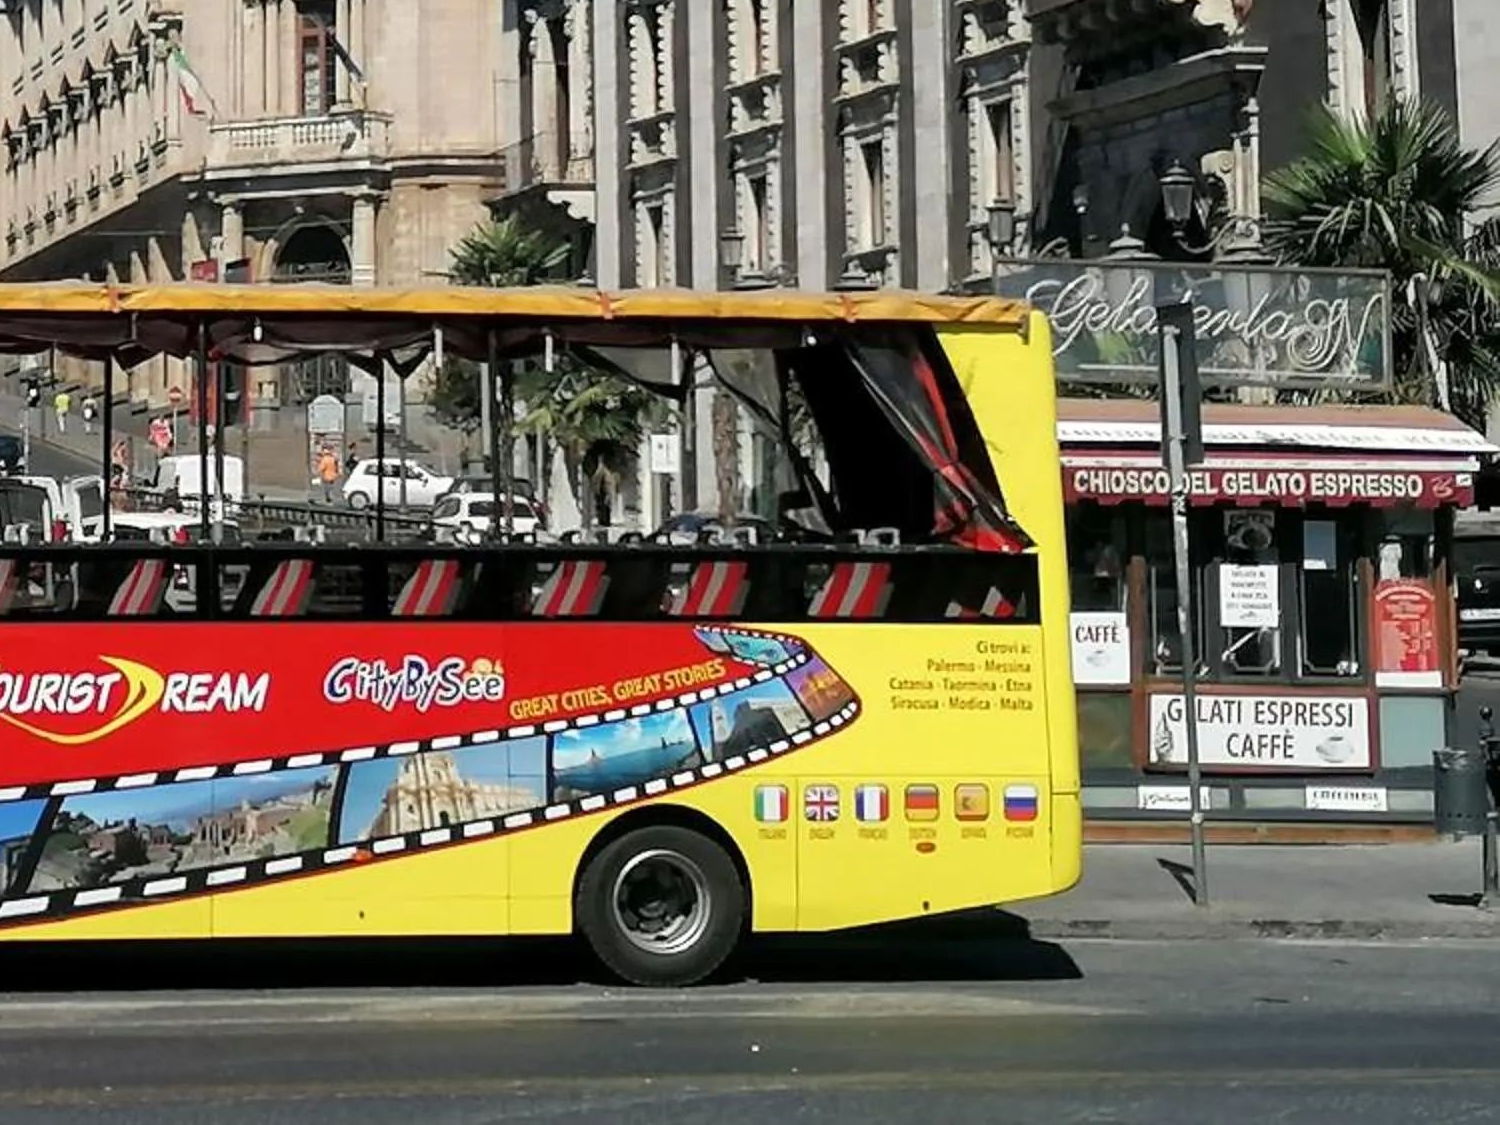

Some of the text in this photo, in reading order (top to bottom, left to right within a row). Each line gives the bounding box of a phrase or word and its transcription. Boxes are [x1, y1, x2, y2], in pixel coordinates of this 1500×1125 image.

[1026, 274, 1296, 356] Gelaeria
[1073, 470, 1171, 494] CHIOSCO
[1221, 472, 1306, 496] GELATO
[1310, 473, 1423, 497] ESPRESSO
[1075, 624, 1121, 645] CAFFÈ
[927, 658, 1031, 673] Palermo Messina
[509, 693, 558, 720] GREAT
[613, 673, 663, 700] GREAT
[663, 658, 726, 691] STORIES
[889, 677, 1032, 692] Catania Taormina Etna
[890, 695, 1034, 711] Siracusa Modica Malta
[1166, 698, 1353, 728] GLATI ESPRESSI
[1226, 729, 1294, 759] CAFFÈ
